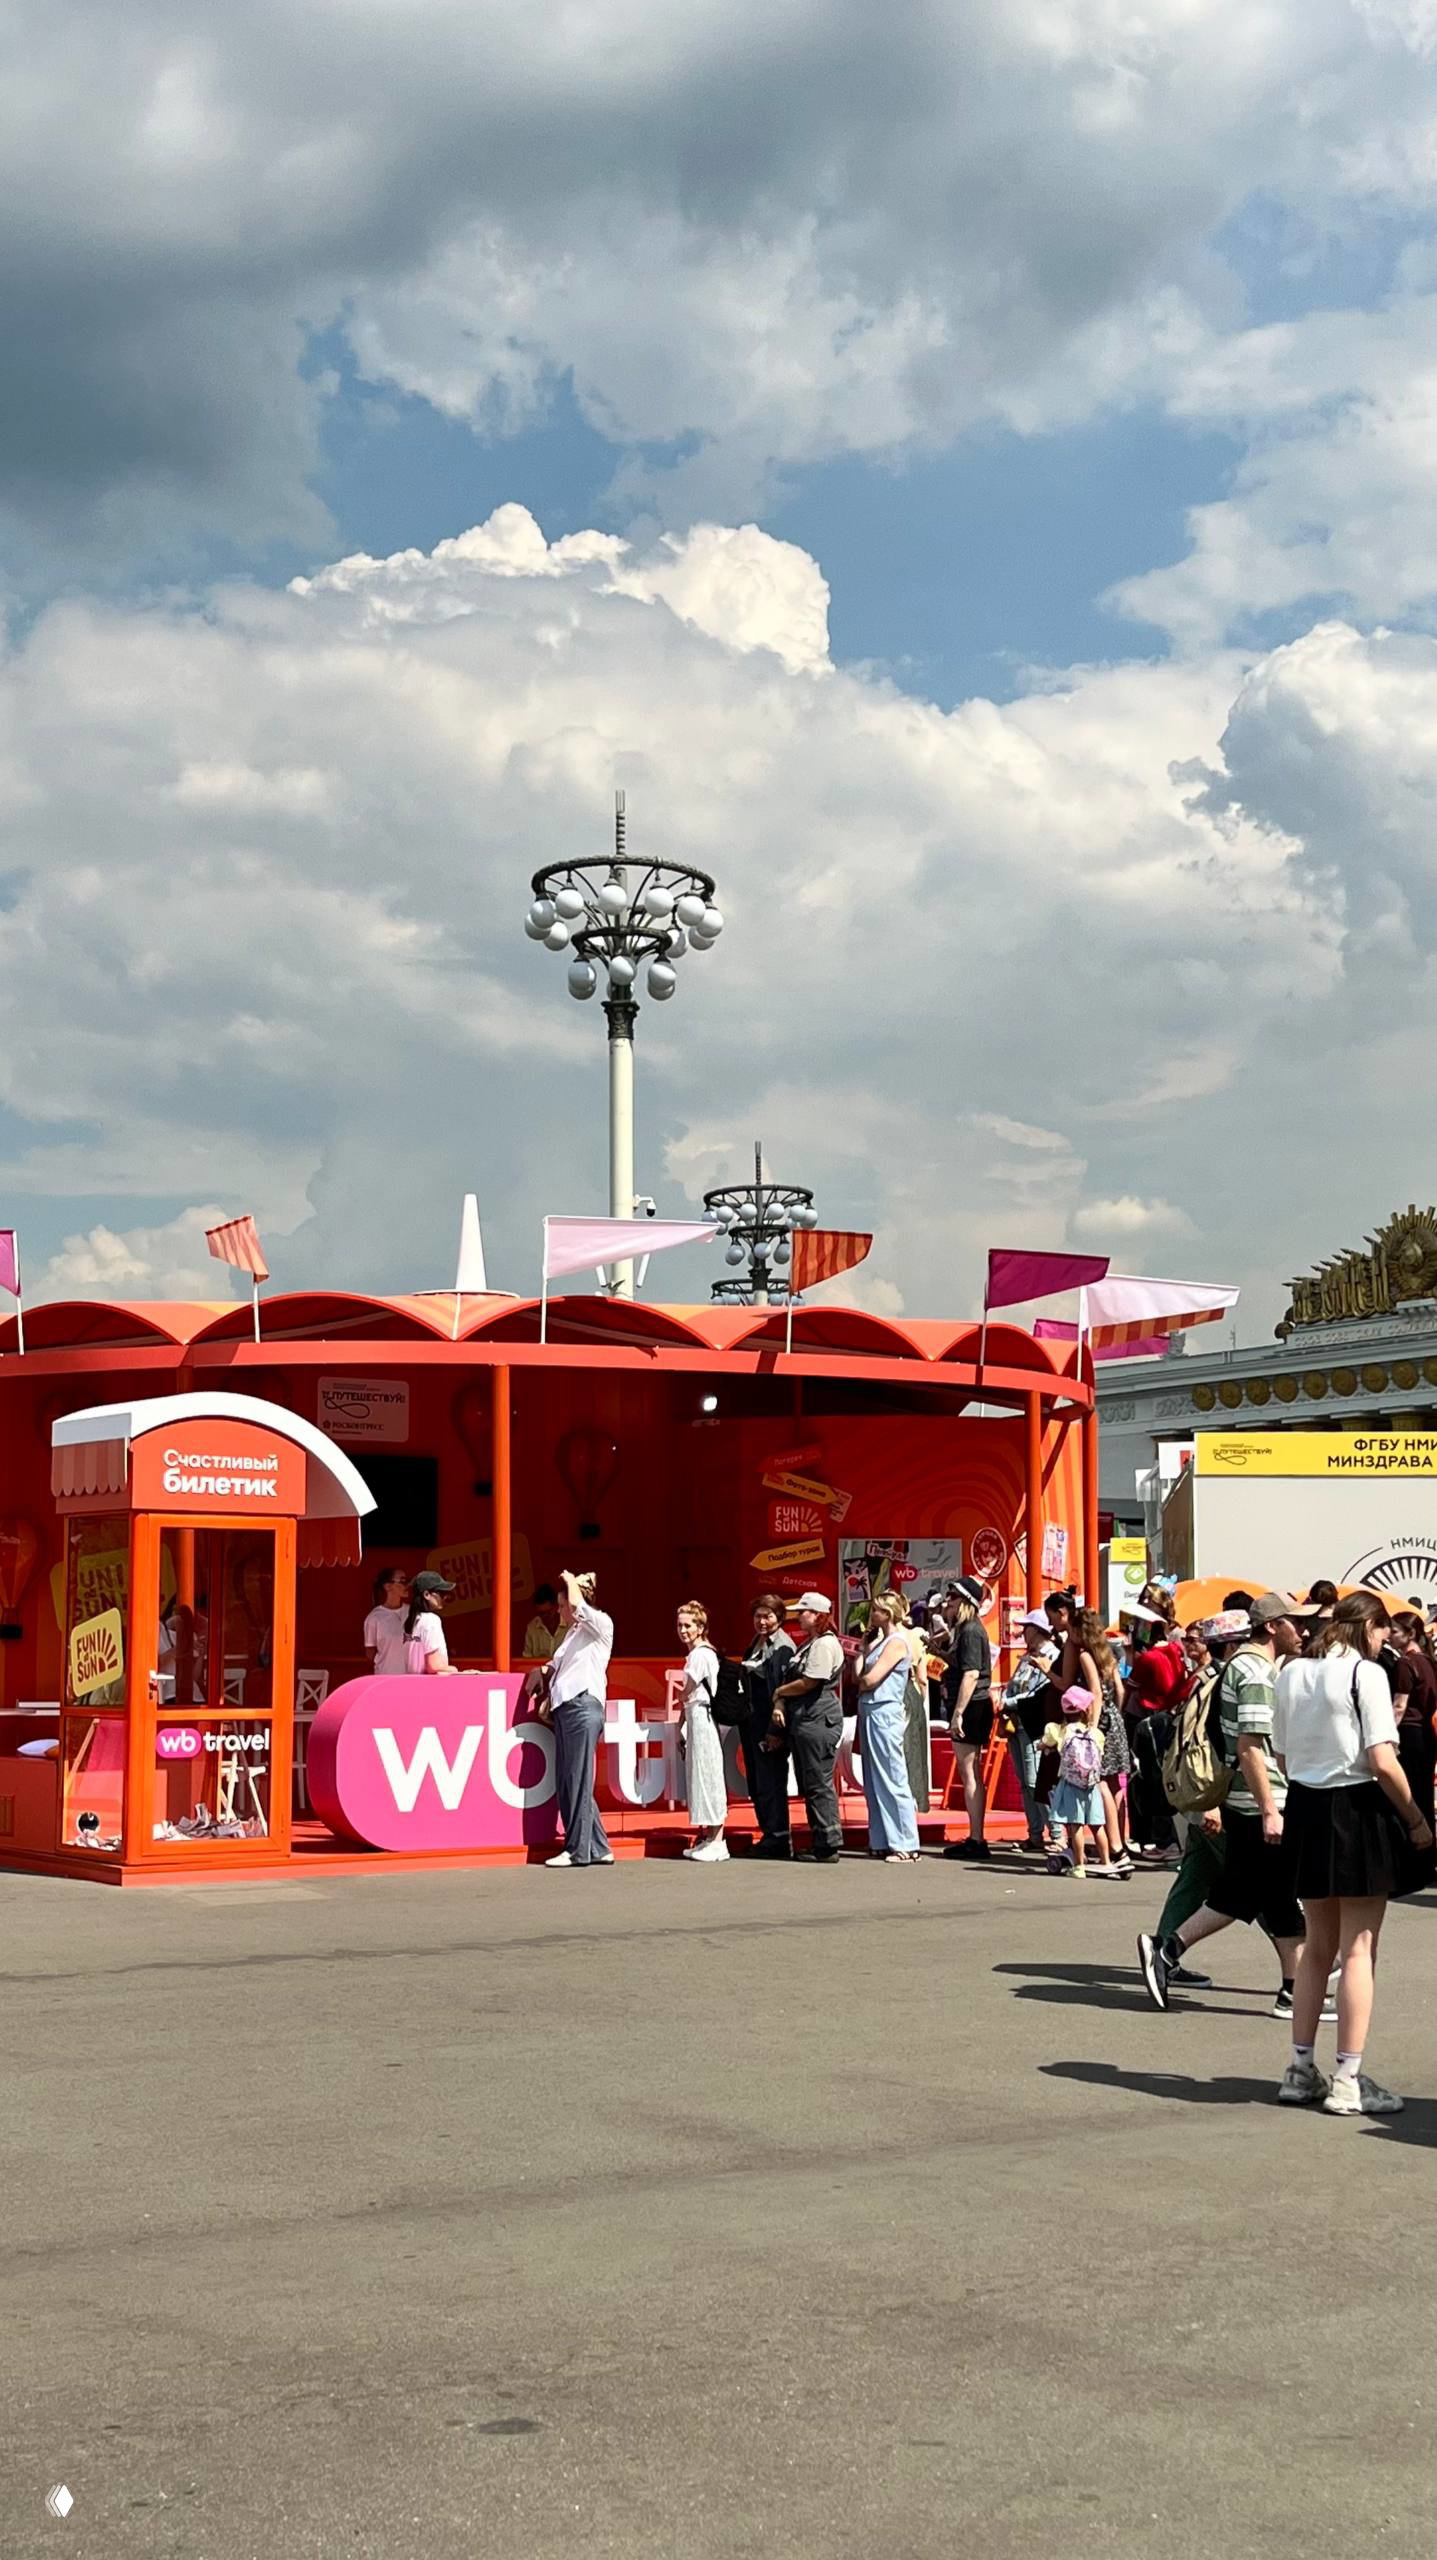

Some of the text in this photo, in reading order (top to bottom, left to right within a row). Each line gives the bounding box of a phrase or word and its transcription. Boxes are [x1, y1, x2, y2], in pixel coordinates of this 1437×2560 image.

[1354, 1438, 1400, 1451] ФГБУ
[163, 1449, 279, 1471] Счастливый
[1327, 1455, 1434, 1469] МИНЗДРАВА
[163, 1467, 278, 1496] билетик
[775, 1506, 799, 1519] FUN
[775, 1519, 799, 1533] SUN
[1390, 1536, 1436, 1551] НМИЦ
[895, 1566, 960, 1578] wb travel
[77, 1633, 96, 1660] FUN
[77, 1656, 98, 1683] SUN
[161, 1728, 270, 1752] wb travel
